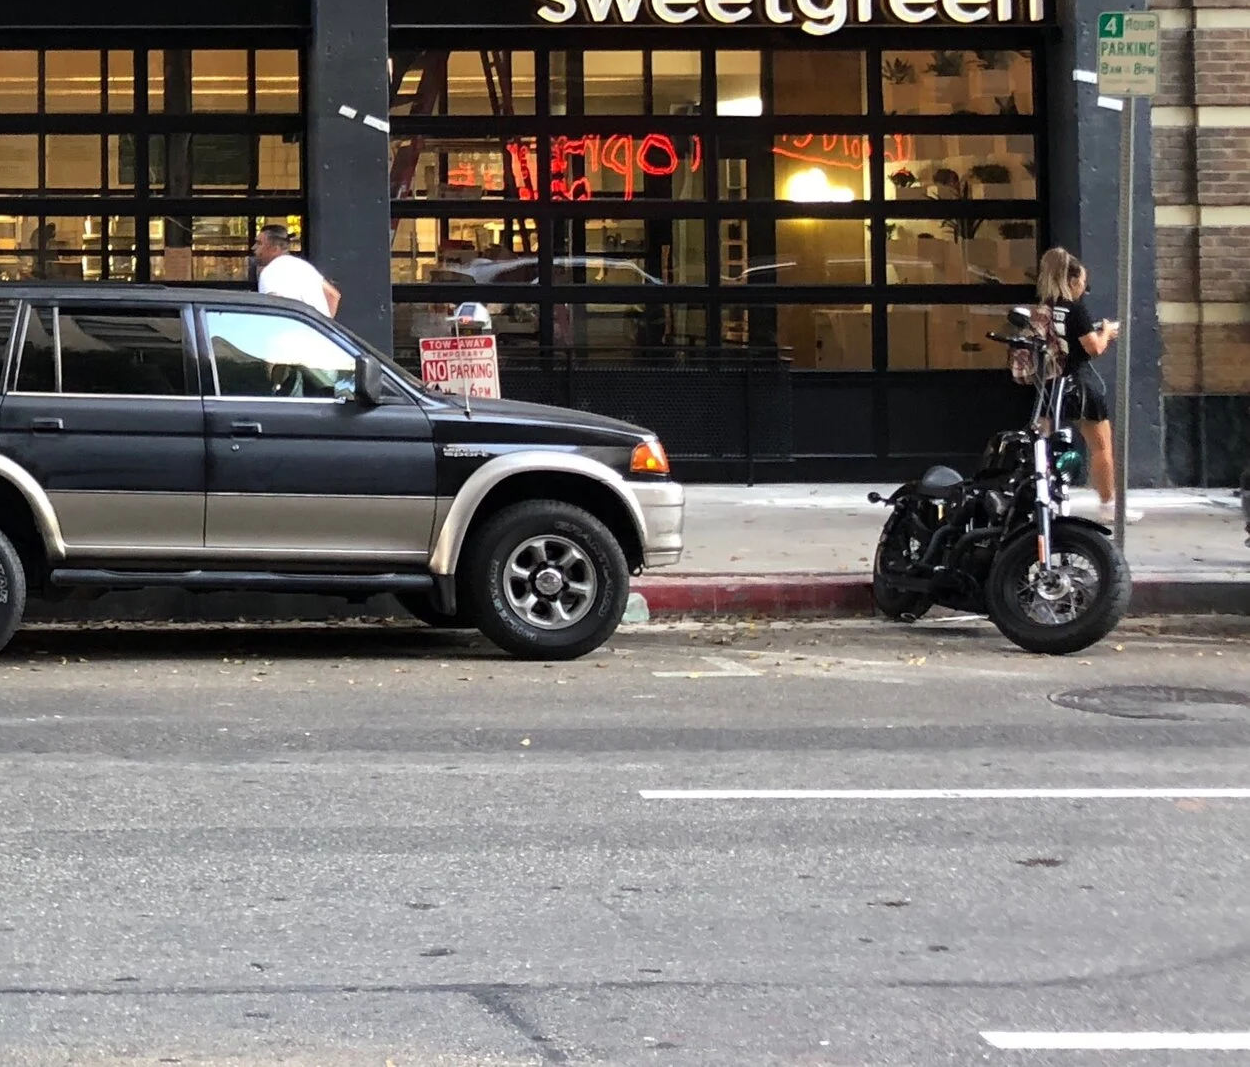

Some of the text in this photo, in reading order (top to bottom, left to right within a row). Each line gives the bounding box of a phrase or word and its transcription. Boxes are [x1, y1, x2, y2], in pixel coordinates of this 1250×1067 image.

[1104, 17, 1117, 35] 4
[1101, 42, 1155, 56] PARKING
[1100, 62, 1155, 75] 8AM 8PM
[428, 339, 486, 350] TOW-AWAY
[432, 350, 484, 359] TEMPORARY
[426, 361, 493, 381] NO PARKING
[470, 383, 491, 397] 6PM
